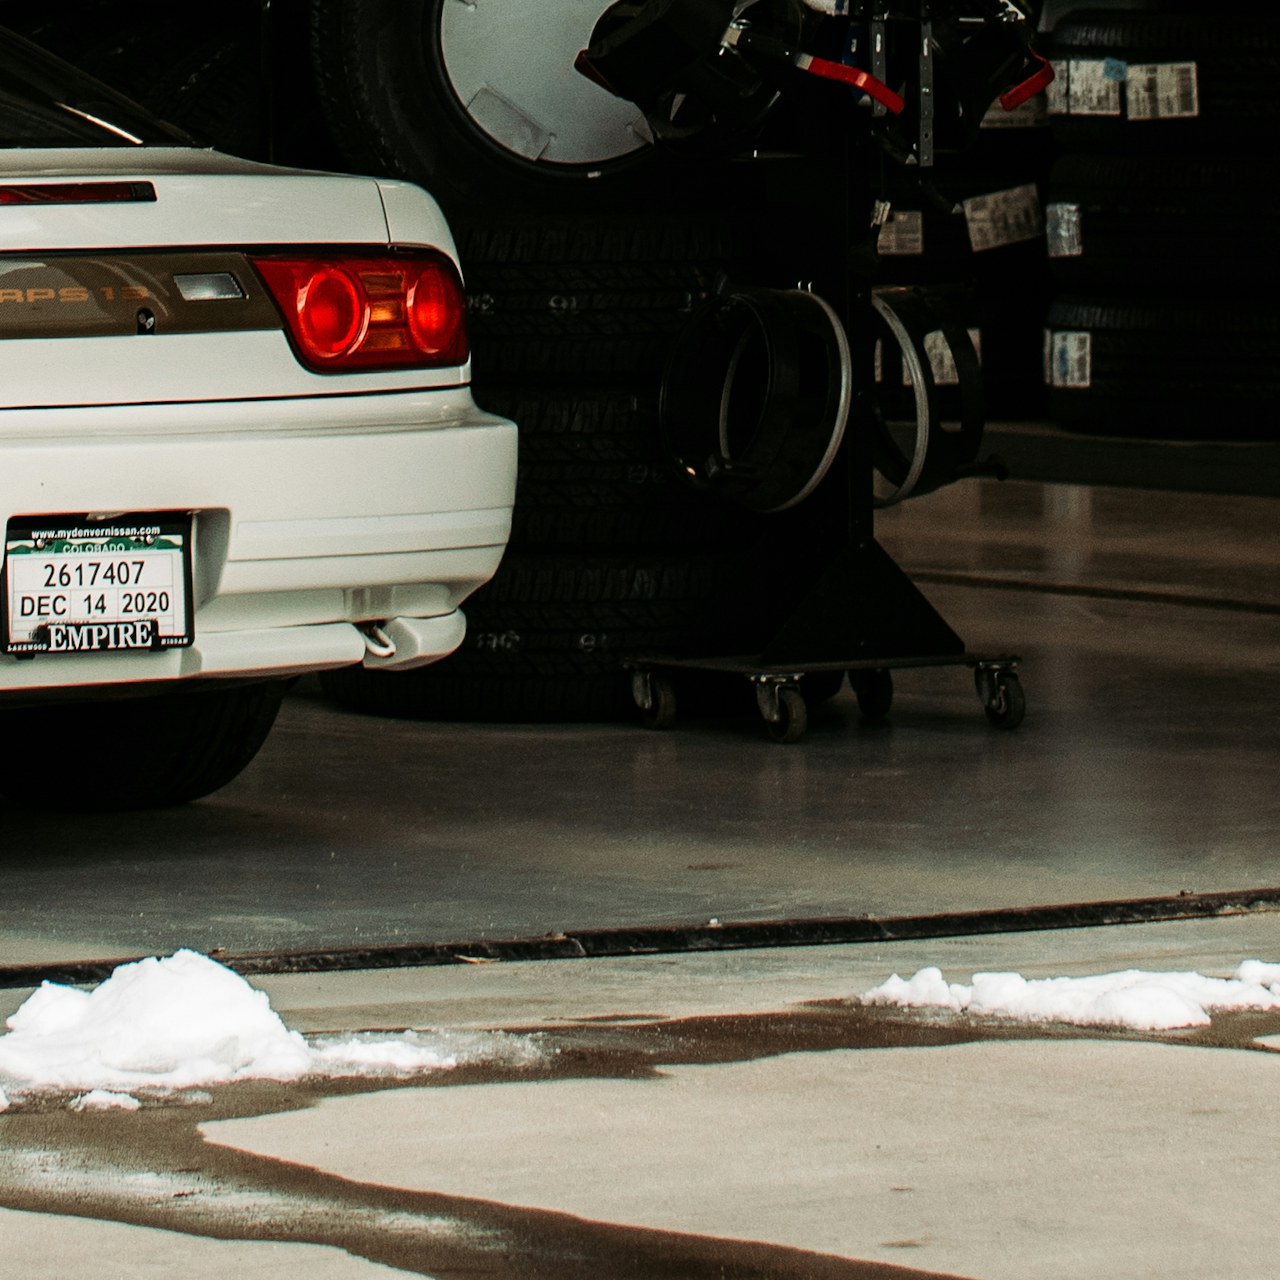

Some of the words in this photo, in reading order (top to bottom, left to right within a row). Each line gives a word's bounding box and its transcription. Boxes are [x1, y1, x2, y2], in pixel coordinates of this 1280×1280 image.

[31, 525, 161, 539] www.mydenvernissan.com
[62, 542, 126, 555] COLORADO
[43, 561, 146, 588] 2617407
[20, 595, 67, 617] DEC
[83, 593, 107, 615] 14
[122, 591, 170, 614] 2020
[48, 621, 153, 652] EMPIRE
